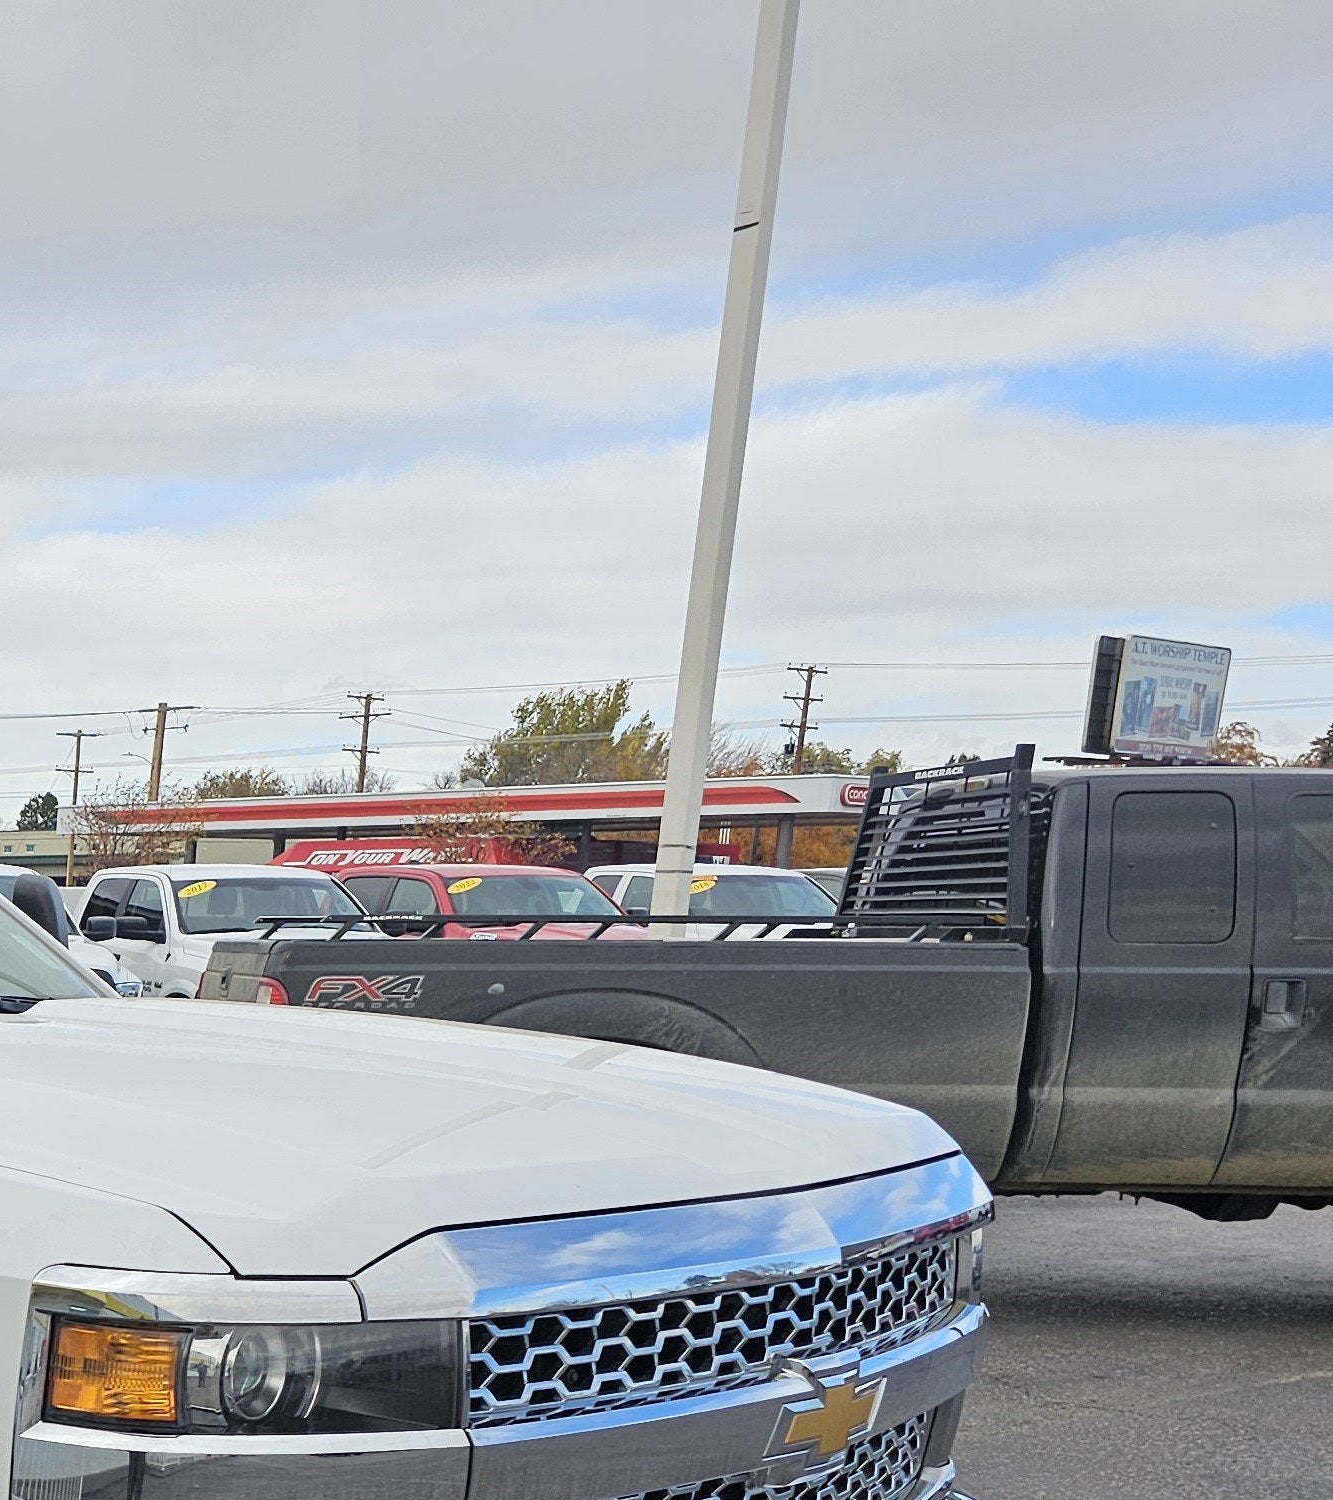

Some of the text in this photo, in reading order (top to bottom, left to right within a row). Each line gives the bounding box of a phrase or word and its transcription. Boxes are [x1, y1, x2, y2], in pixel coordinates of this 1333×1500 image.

[1151, 643, 1192, 660] WORSHIP
[1193, 648, 1225, 666] TEMPLE
[914, 765, 965, 780] BACKRACK
[311, 852, 340, 865] ON
[337, 849, 396, 866] YOUR
[306, 975, 426, 1001] FX4
